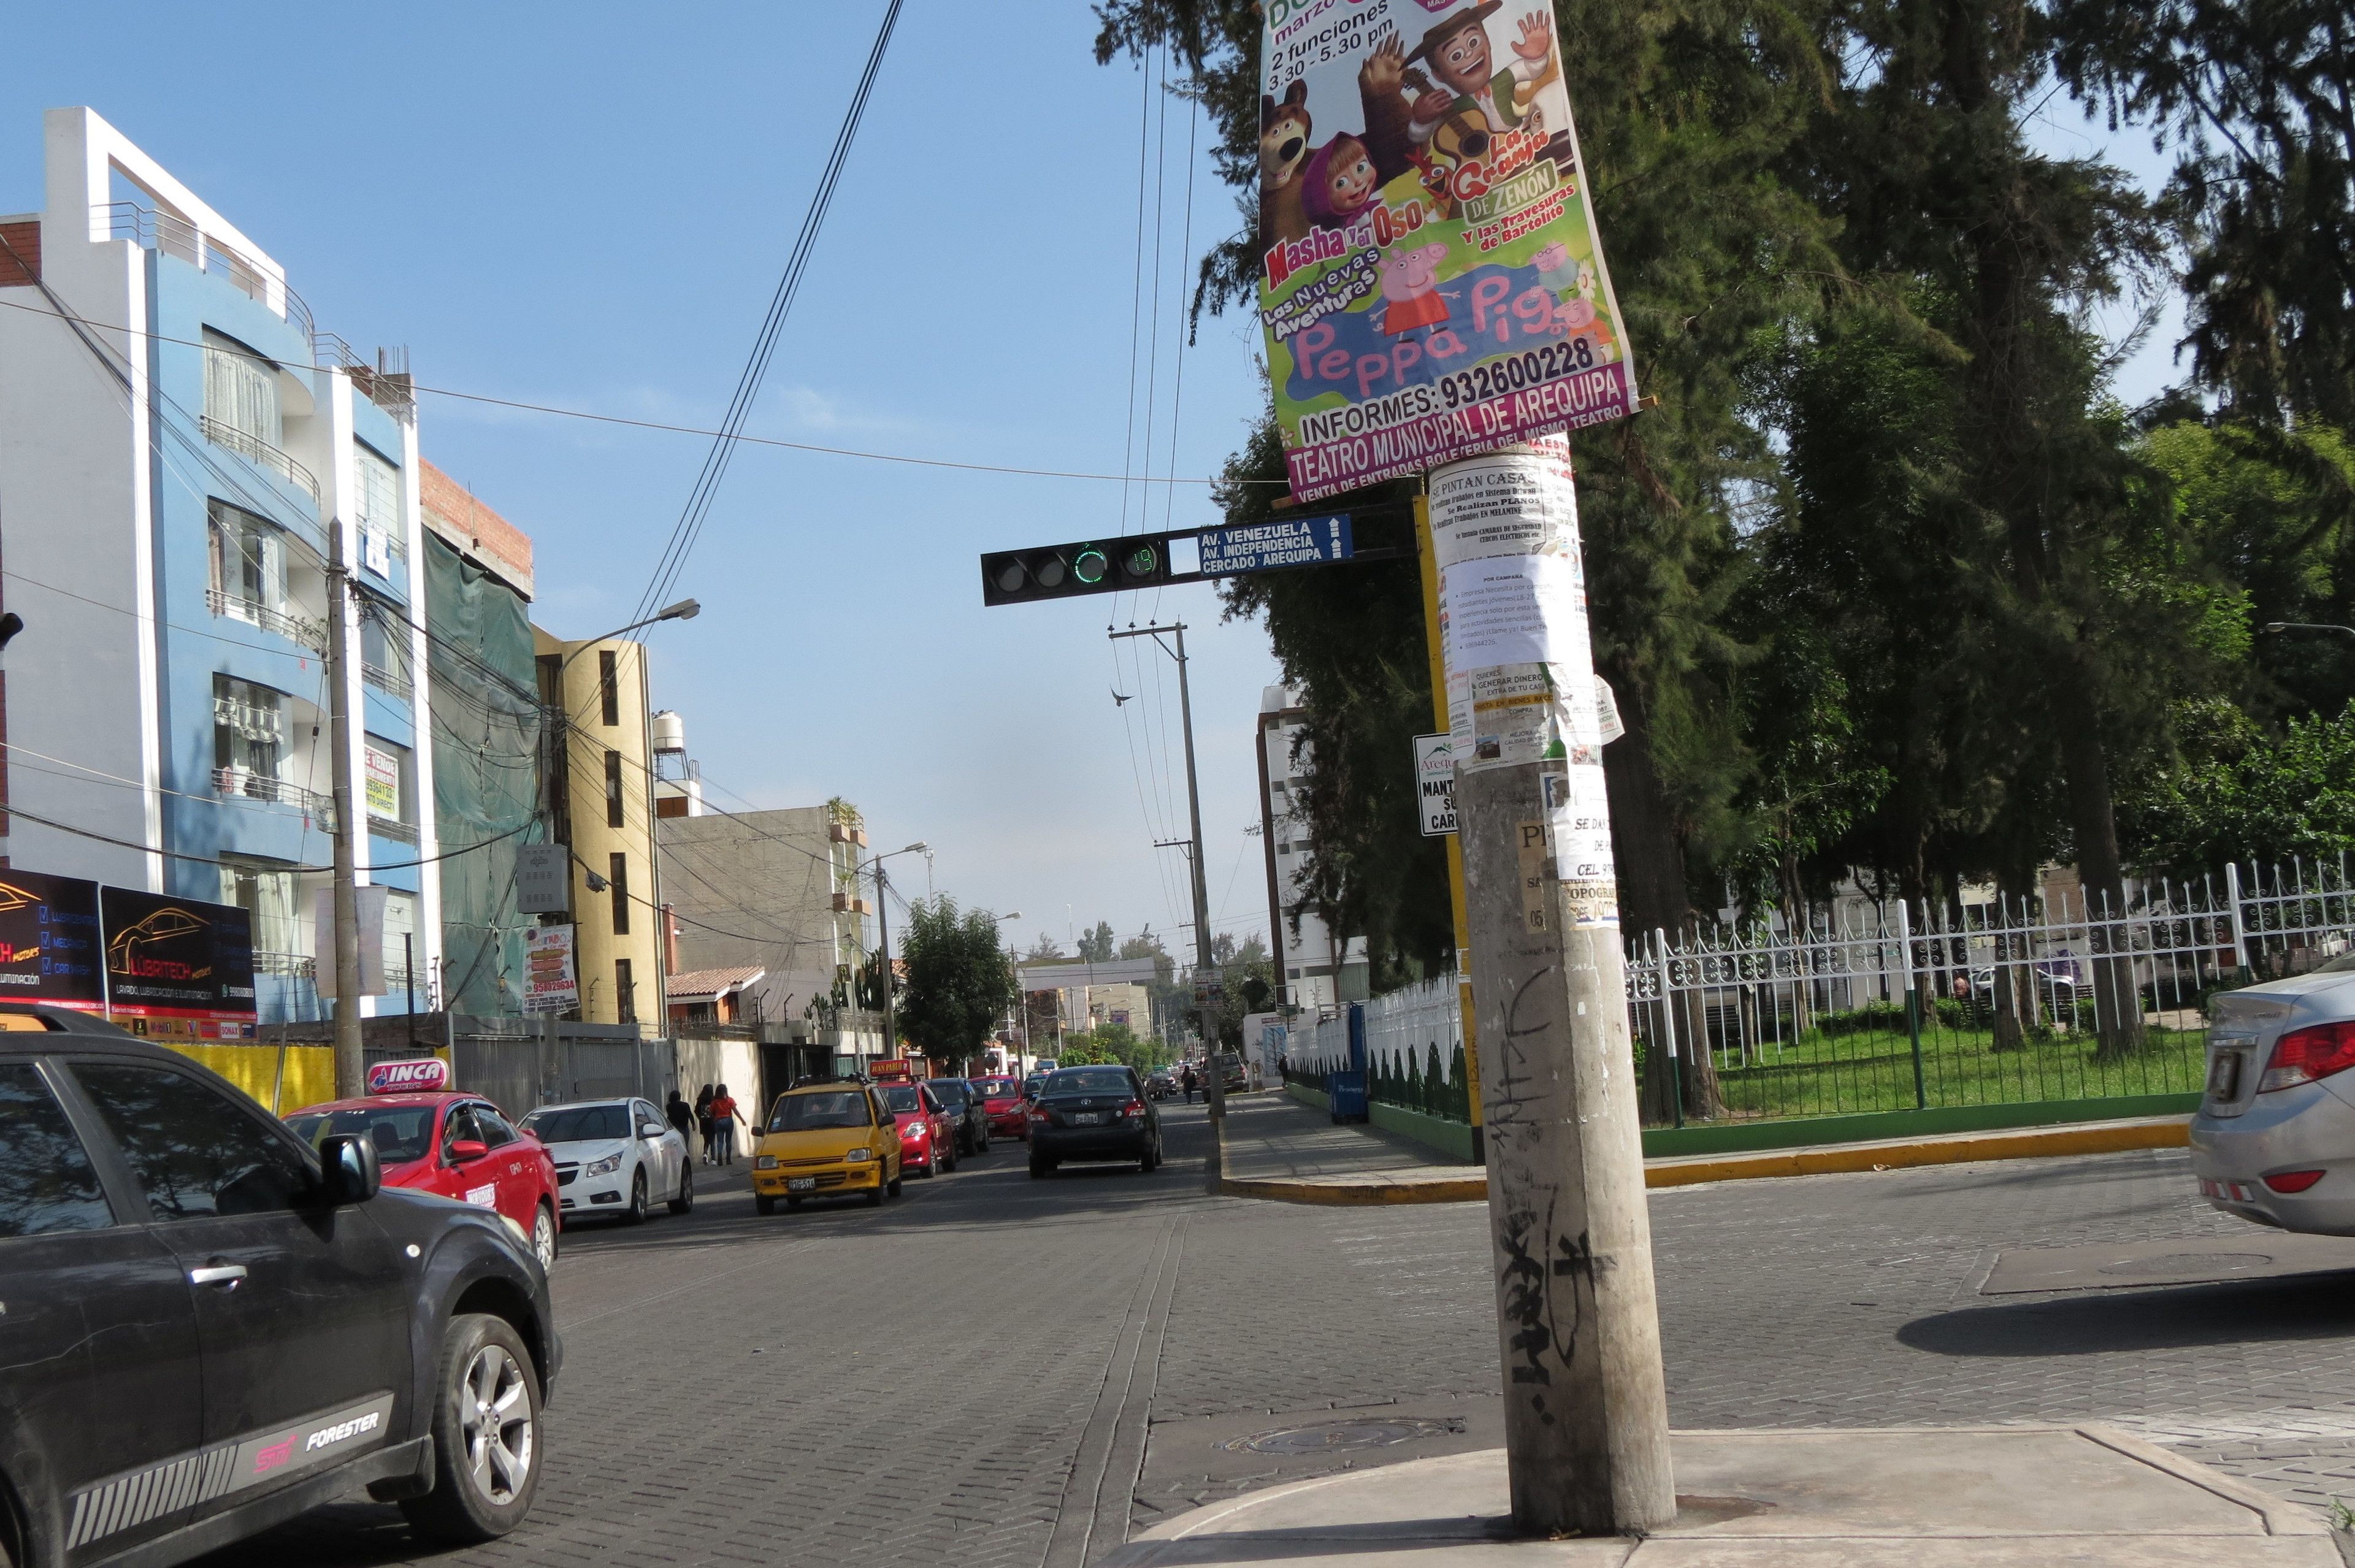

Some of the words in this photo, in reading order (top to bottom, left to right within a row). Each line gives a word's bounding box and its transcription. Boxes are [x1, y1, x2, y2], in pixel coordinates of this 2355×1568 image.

[1272, 52, 1283, 71] 2
[1287, 1, 1388, 62] funciones
[1274, 0, 1335, 46] marzo
[1268, 60, 1305, 91] 3.30
[1320, 33, 1361, 62] 5.30
[1368, 18, 1393, 47] pm
[1490, 129, 1522, 164] La
[1453, 130, 1549, 201] Granja
[1471, 197, 1491, 218] DE
[1492, 167, 1551, 215] ZENÓN
[1462, 231, 1472, 244] Y
[1477, 223, 1499, 239] las
[1500, 184, 1575, 229] Travesuras
[1480, 237, 1498, 251] de
[1501, 205, 1564, 243] Bartolito
[1265, 225, 1347, 293] Masha
[1357, 228, 1371, 249] el
[1371, 199, 1424, 248] Oso
[1263, 300, 1294, 326] Las
[1295, 249, 1379, 306] Nuevas
[1275, 269, 1376, 340] Aventuras
[1295, 323, 1468, 397] Peppa
[1472, 275, 1557, 343] Pig
[1302, 387, 1440, 443] INFORMES:
[1441, 337, 1593, 409] 932600228
[1291, 438, 1368, 486] TEATRO
[1373, 408, 1480, 467] MUNICIPAL
[1479, 397, 1511, 436] DE
[1515, 368, 1622, 428] AREQUIPA
[1298, 483, 1339, 503] VENTA
[1340, 478, 1357, 492] DE
[1360, 459, 1424, 487] ENTRADAS
[1424, 438, 1494, 468] BOLETERIA
[1497, 435, 1523, 448] DEL
[1525, 420, 1568, 440] MISMO
[1570, 404, 1623, 430] TEATRO
[1442, 476, 1483, 494] PINTAN
[1487, 473, 1536, 485] CASAS
[1485, 488, 1511, 497] Sistema
[1454, 512, 1479, 523] Trabajos
[1490, 506, 1522, 517] MELAMINE
[1457, 501, 1498, 512] Realizan
[1501, 497, 1541, 506] PLANOS
[1201, 533, 1220, 547] AV.
[1225, 522, 1312, 543] VENEZUELA
[1479, 526, 1503, 535] CAMARAS
[1202, 557, 1255, 573] CERCADO
[1263, 548, 1322, 566] AREQUIPA
[1203, 546, 1219, 560] AV.
[1223, 535, 1314, 557] INDEPENDENCIA
[1461, 589, 1484, 599] Empresa
[1485, 586, 1513, 595] Necesita
[1471, 616, 1503, 627] actividades
[1505, 614, 1533, 623] sencillas
[1478, 676, 1512, 689] GENERAR
[1514, 673, 1543, 684] DINERO
[1487, 687, 1507, 696] EXTRA
[1508, 697, 1531, 705] BIENES
[1574, 818, 1590, 830] SE
[116, 984, 140, 996] LAVADO,
[388, 1063, 441, 1083] INCA
[305, 1411, 380, 1453] FORESTER
